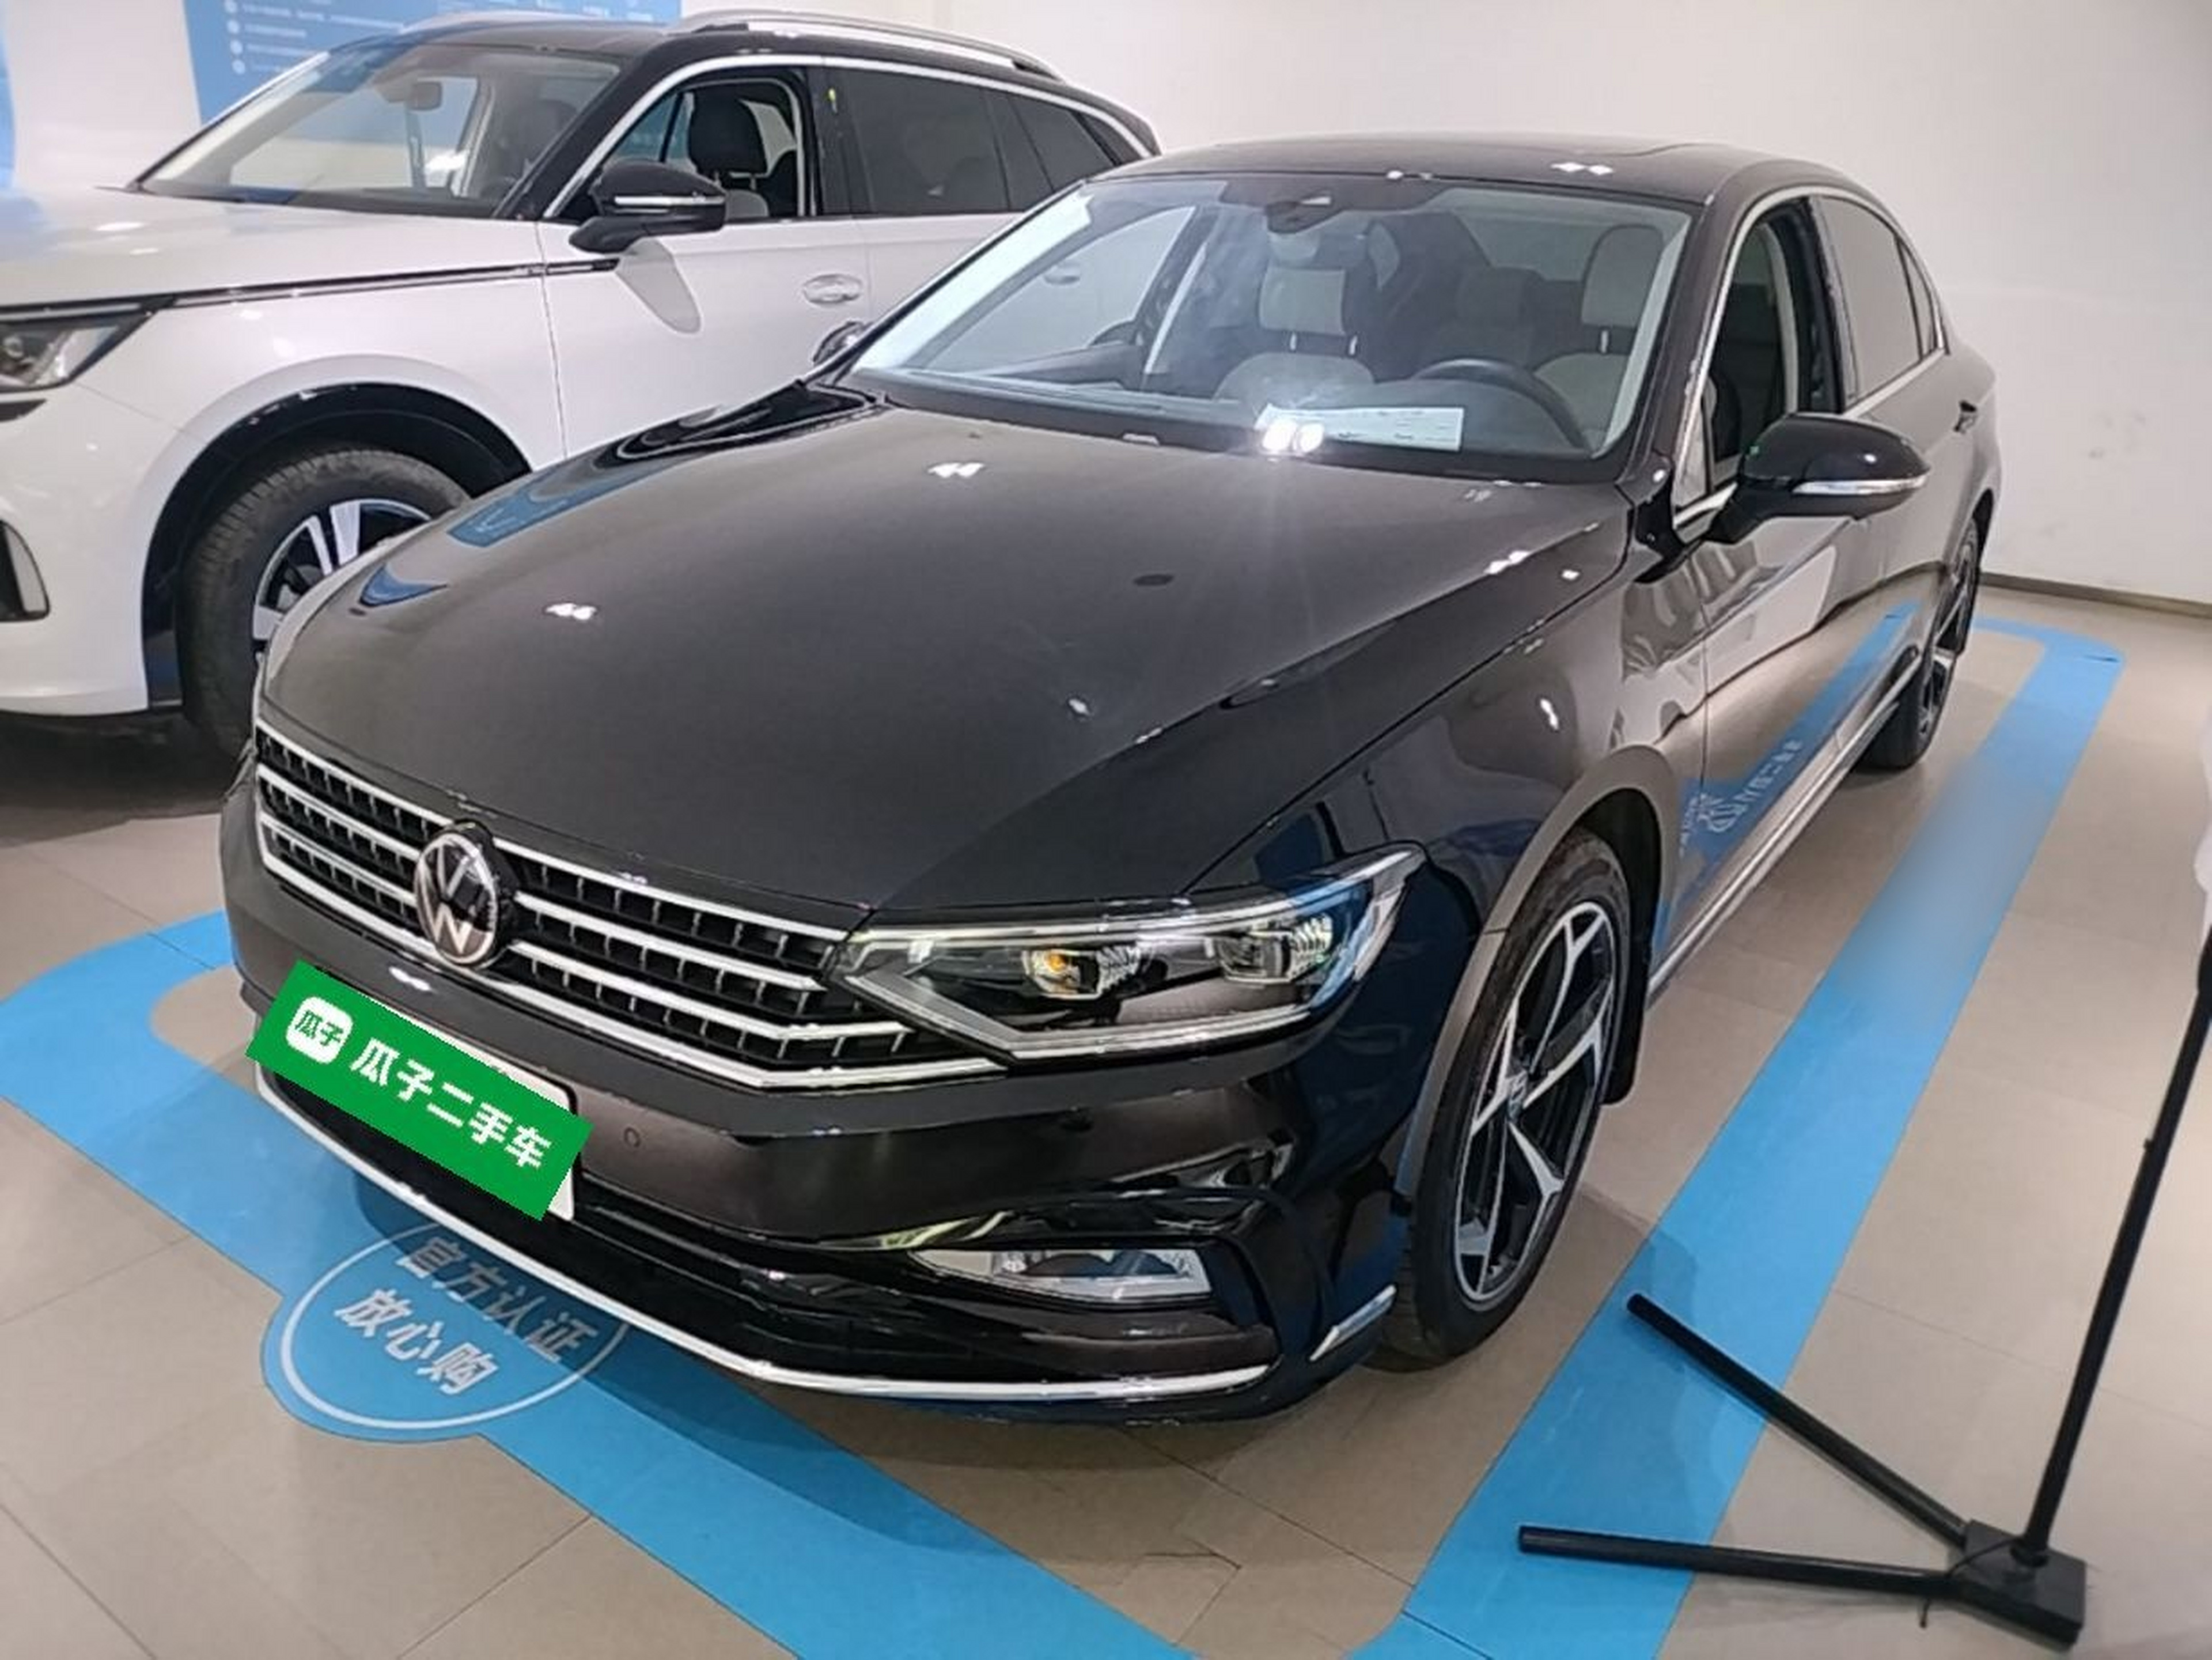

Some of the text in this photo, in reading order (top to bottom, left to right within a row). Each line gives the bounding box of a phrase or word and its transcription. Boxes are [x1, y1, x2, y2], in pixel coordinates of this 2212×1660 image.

[334, 1288, 499, 1395] 放心购
[395, 1236, 599, 1364] 官方认证
